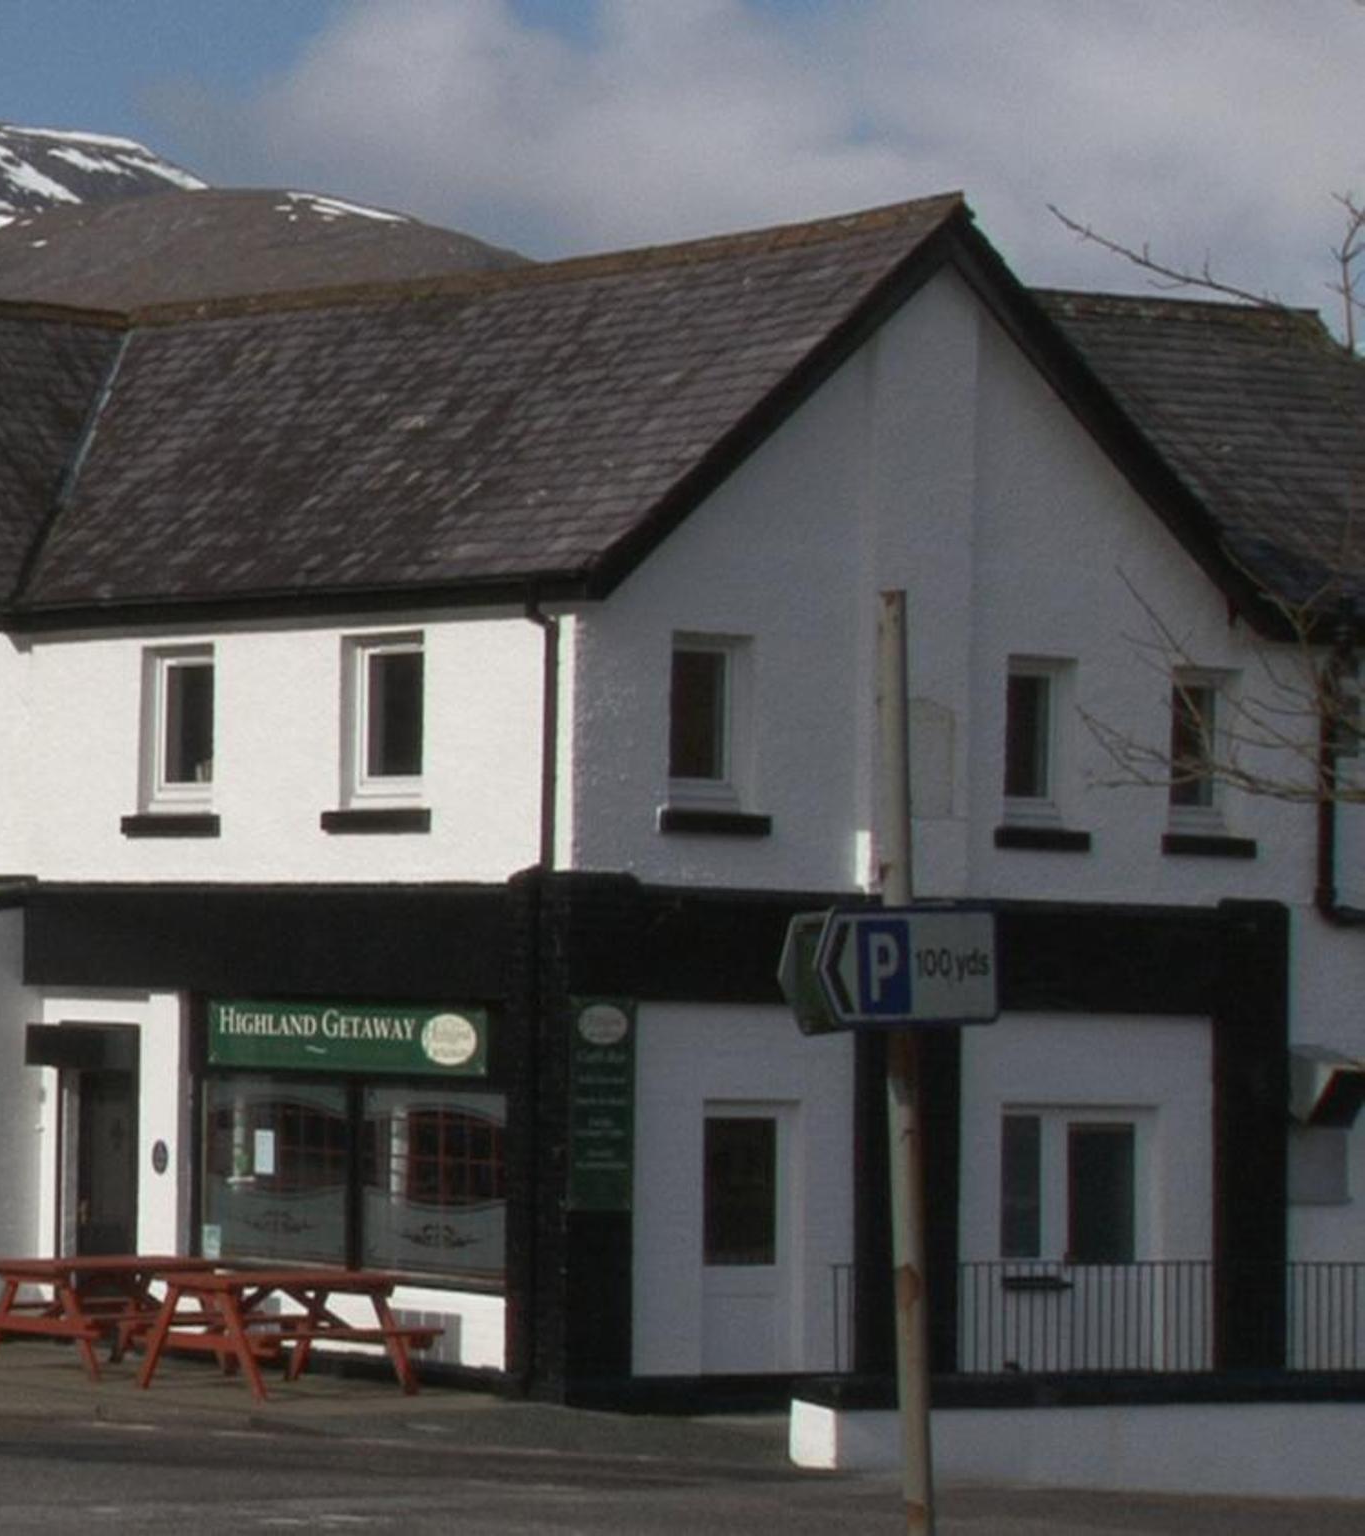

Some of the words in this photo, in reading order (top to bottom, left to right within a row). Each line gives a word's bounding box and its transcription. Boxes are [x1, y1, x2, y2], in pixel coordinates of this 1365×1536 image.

[868, 931, 899, 1002] P
[915, 948, 953, 979] 100
[955, 946, 991, 983] yds
[219, 1006, 318, 1036] HIGHLAND
[322, 1008, 416, 1040] GETAWAY
